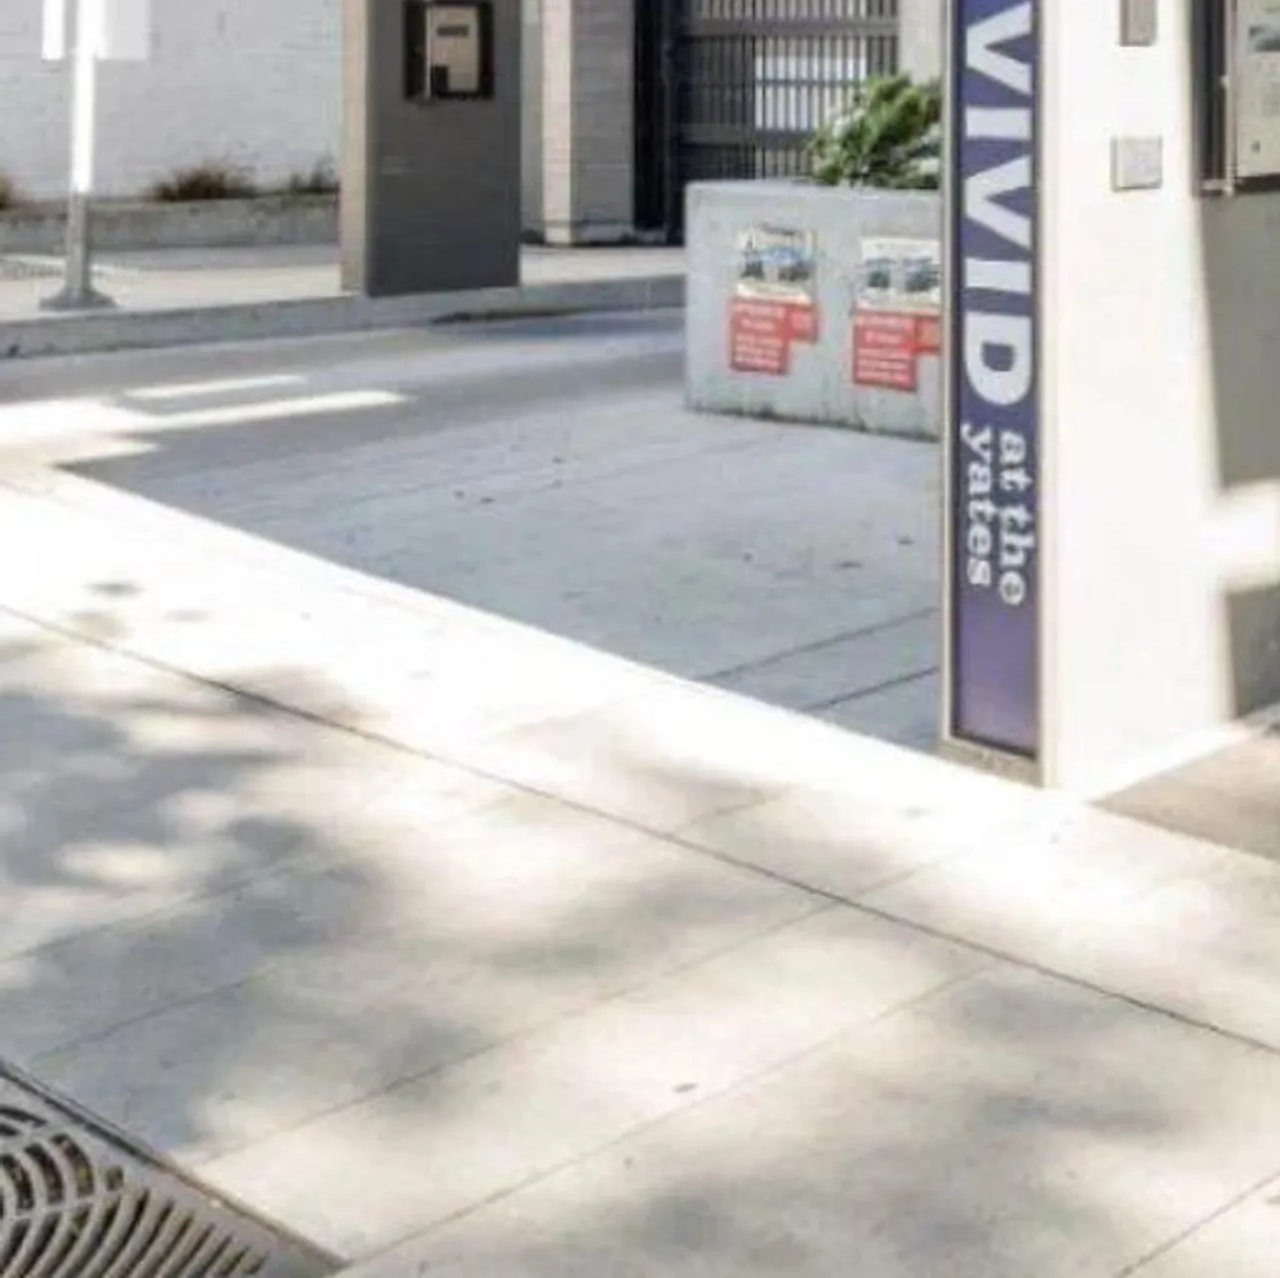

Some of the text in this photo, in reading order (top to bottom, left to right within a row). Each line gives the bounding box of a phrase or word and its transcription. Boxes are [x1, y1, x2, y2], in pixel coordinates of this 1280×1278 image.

[965, 1, 1033, 406] VIVID
[961, 423, 993, 587] yates
[1000, 430, 1036, 606] at the
